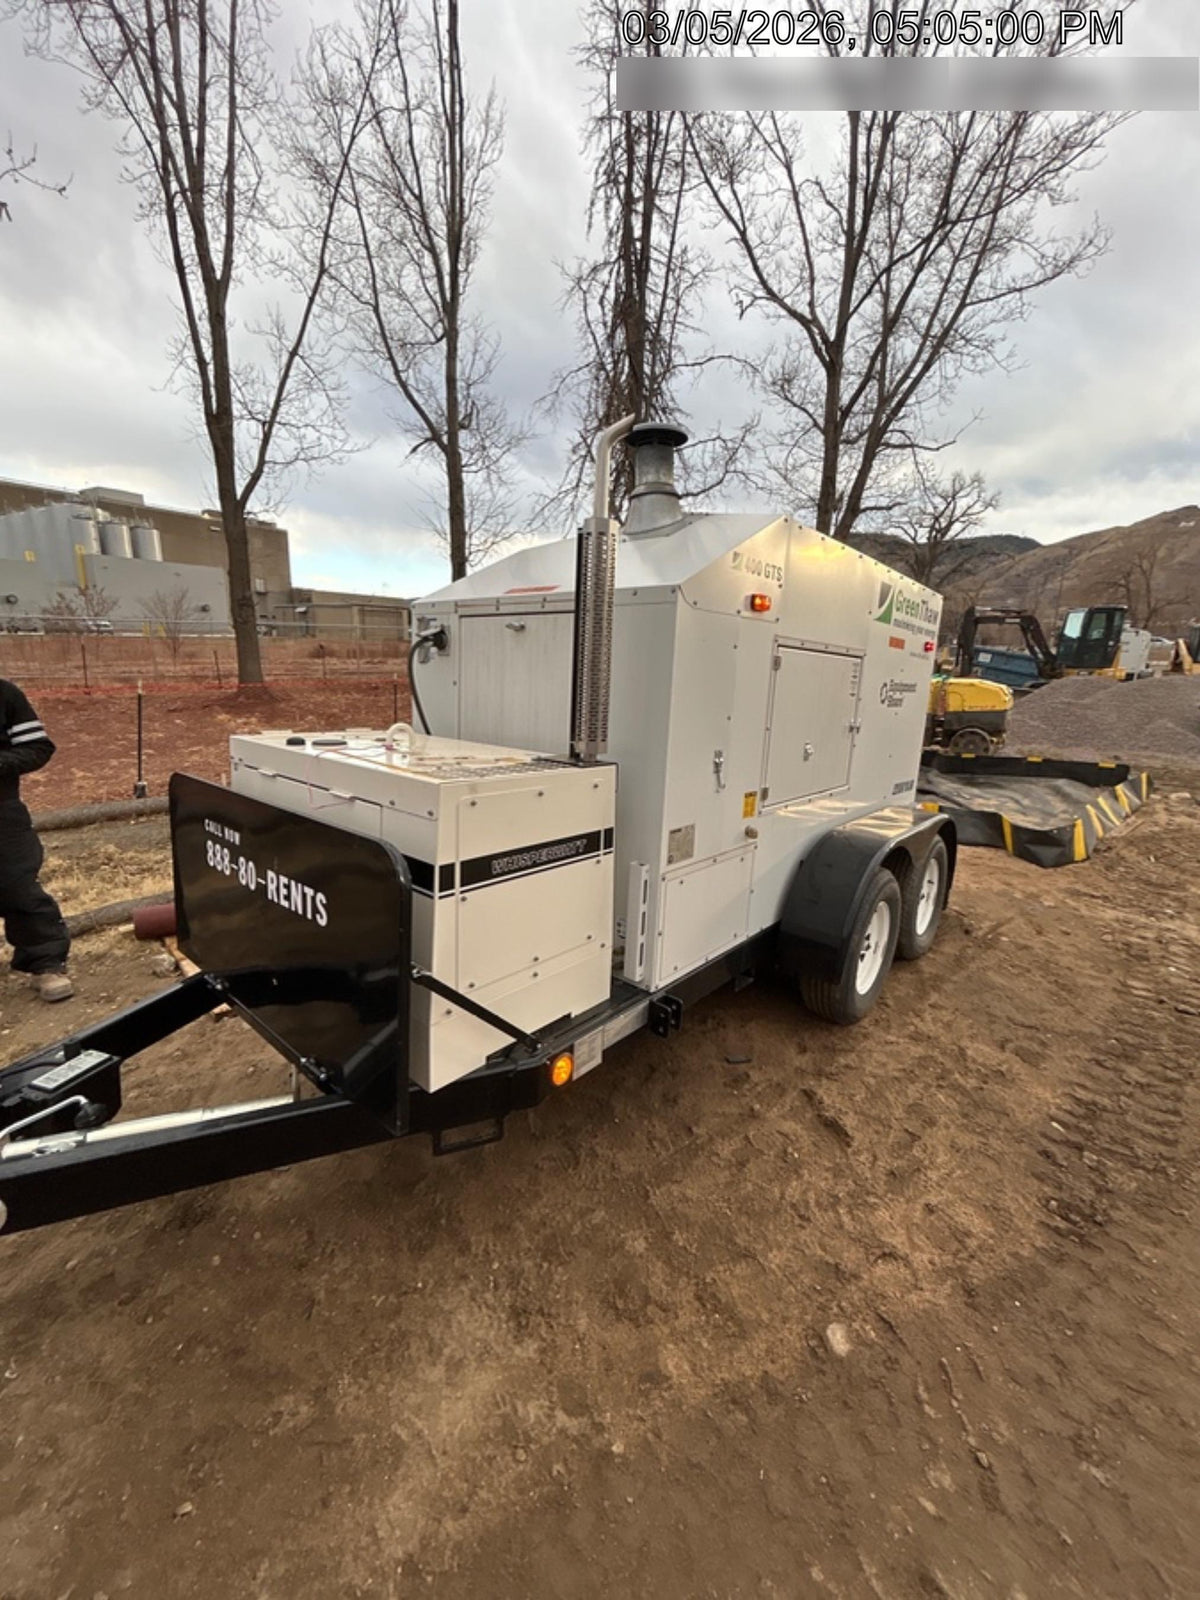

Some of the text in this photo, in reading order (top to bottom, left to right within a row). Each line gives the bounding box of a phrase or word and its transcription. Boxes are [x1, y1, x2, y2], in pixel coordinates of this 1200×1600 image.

[764, 562, 783, 582] GTS
[204, 818, 241, 846] CALL NOW
[205, 840, 329, 927] 888-80-RENTS
